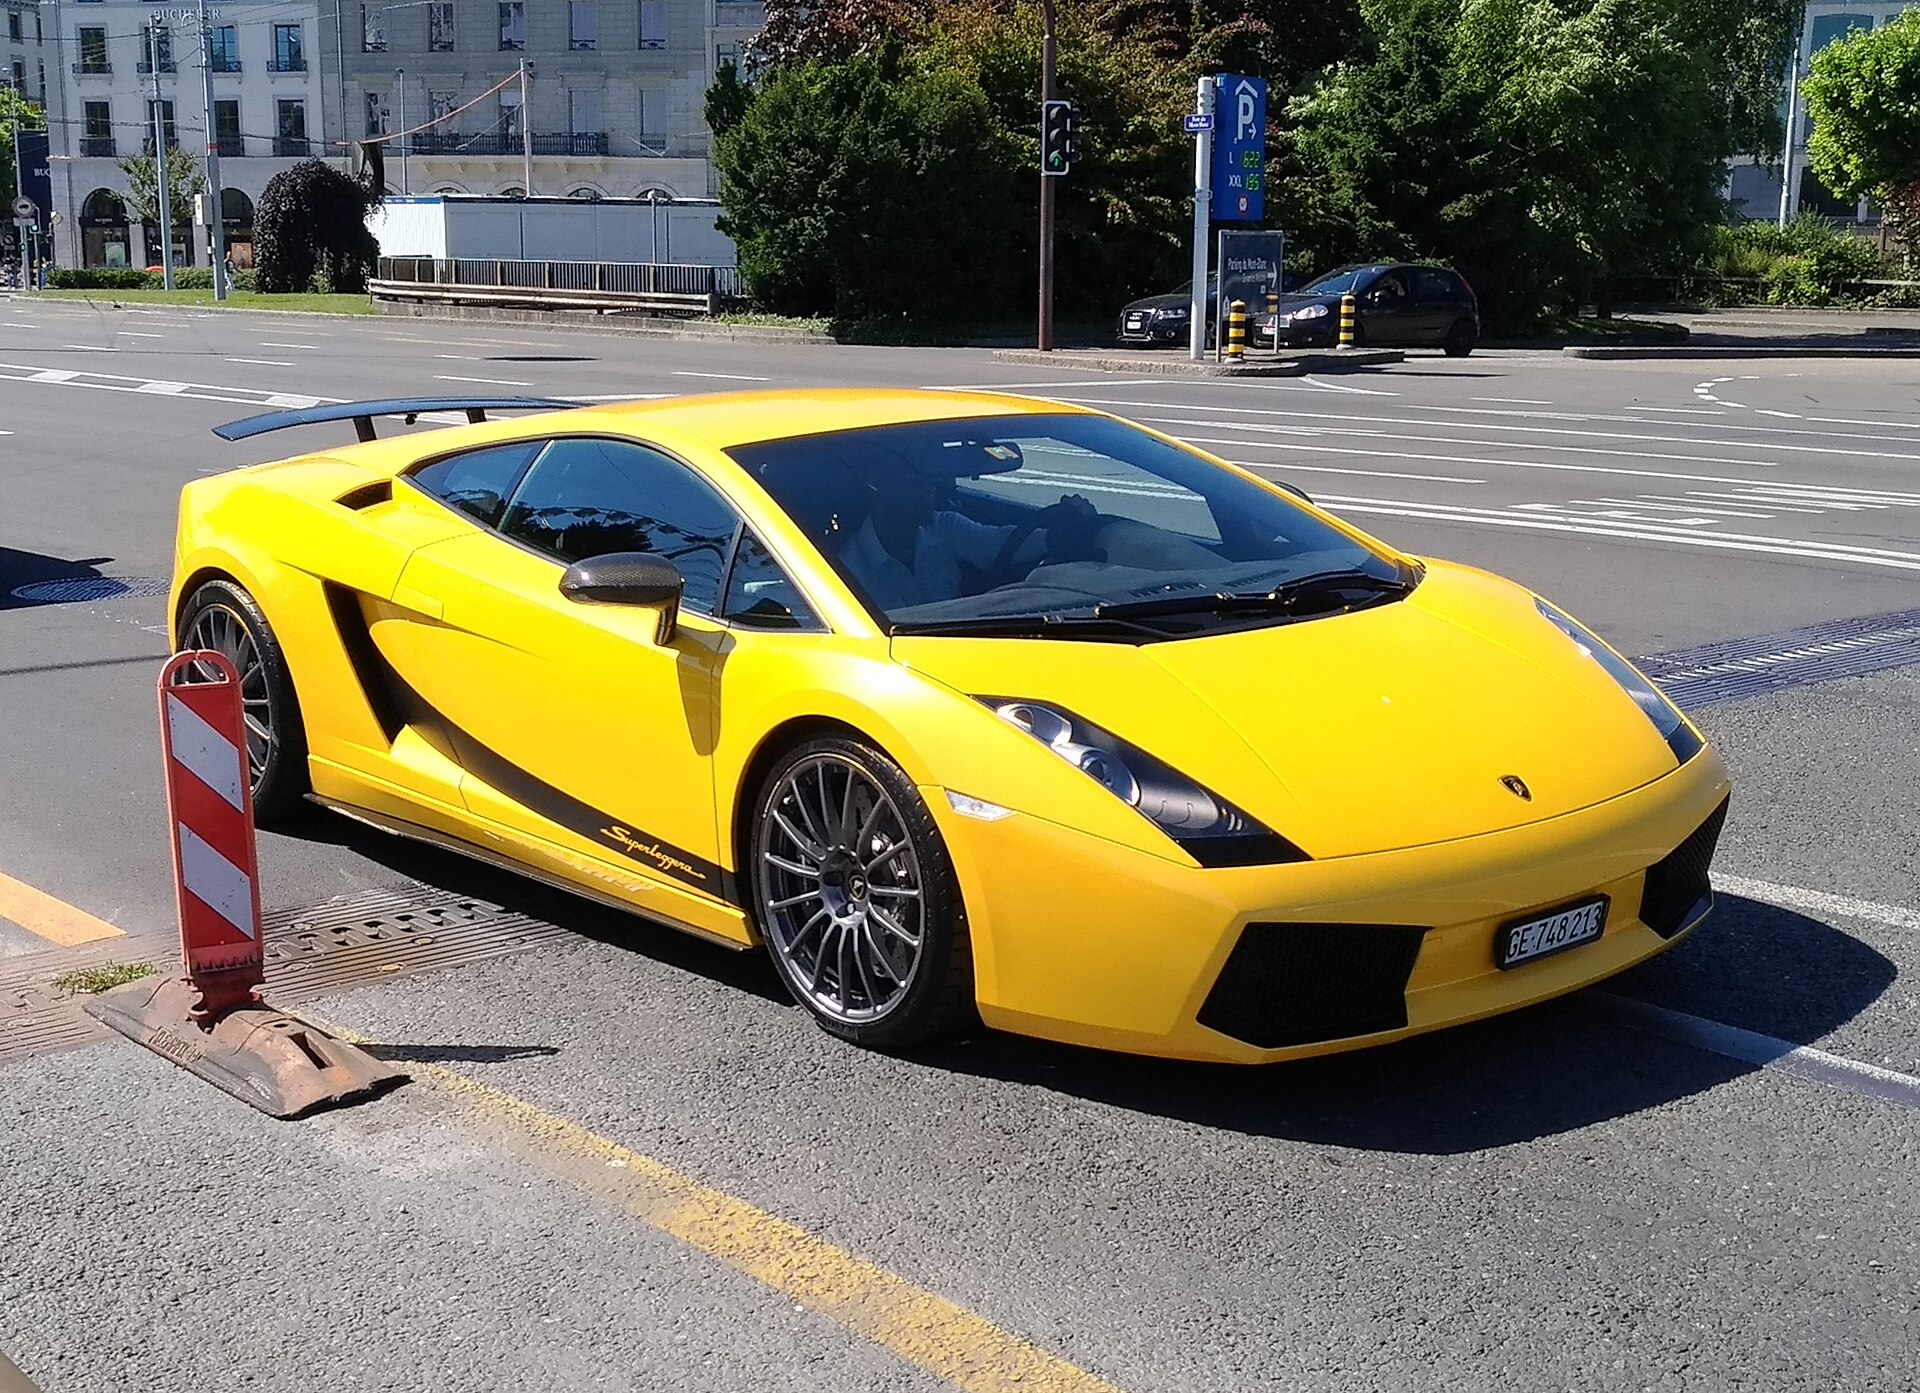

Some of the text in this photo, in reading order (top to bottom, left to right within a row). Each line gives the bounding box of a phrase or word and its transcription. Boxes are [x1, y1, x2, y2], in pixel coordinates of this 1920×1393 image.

[1238, 94, 1254, 140] P
[1229, 151, 1233, 164] L
[600, 825, 707, 880] Superleggera
